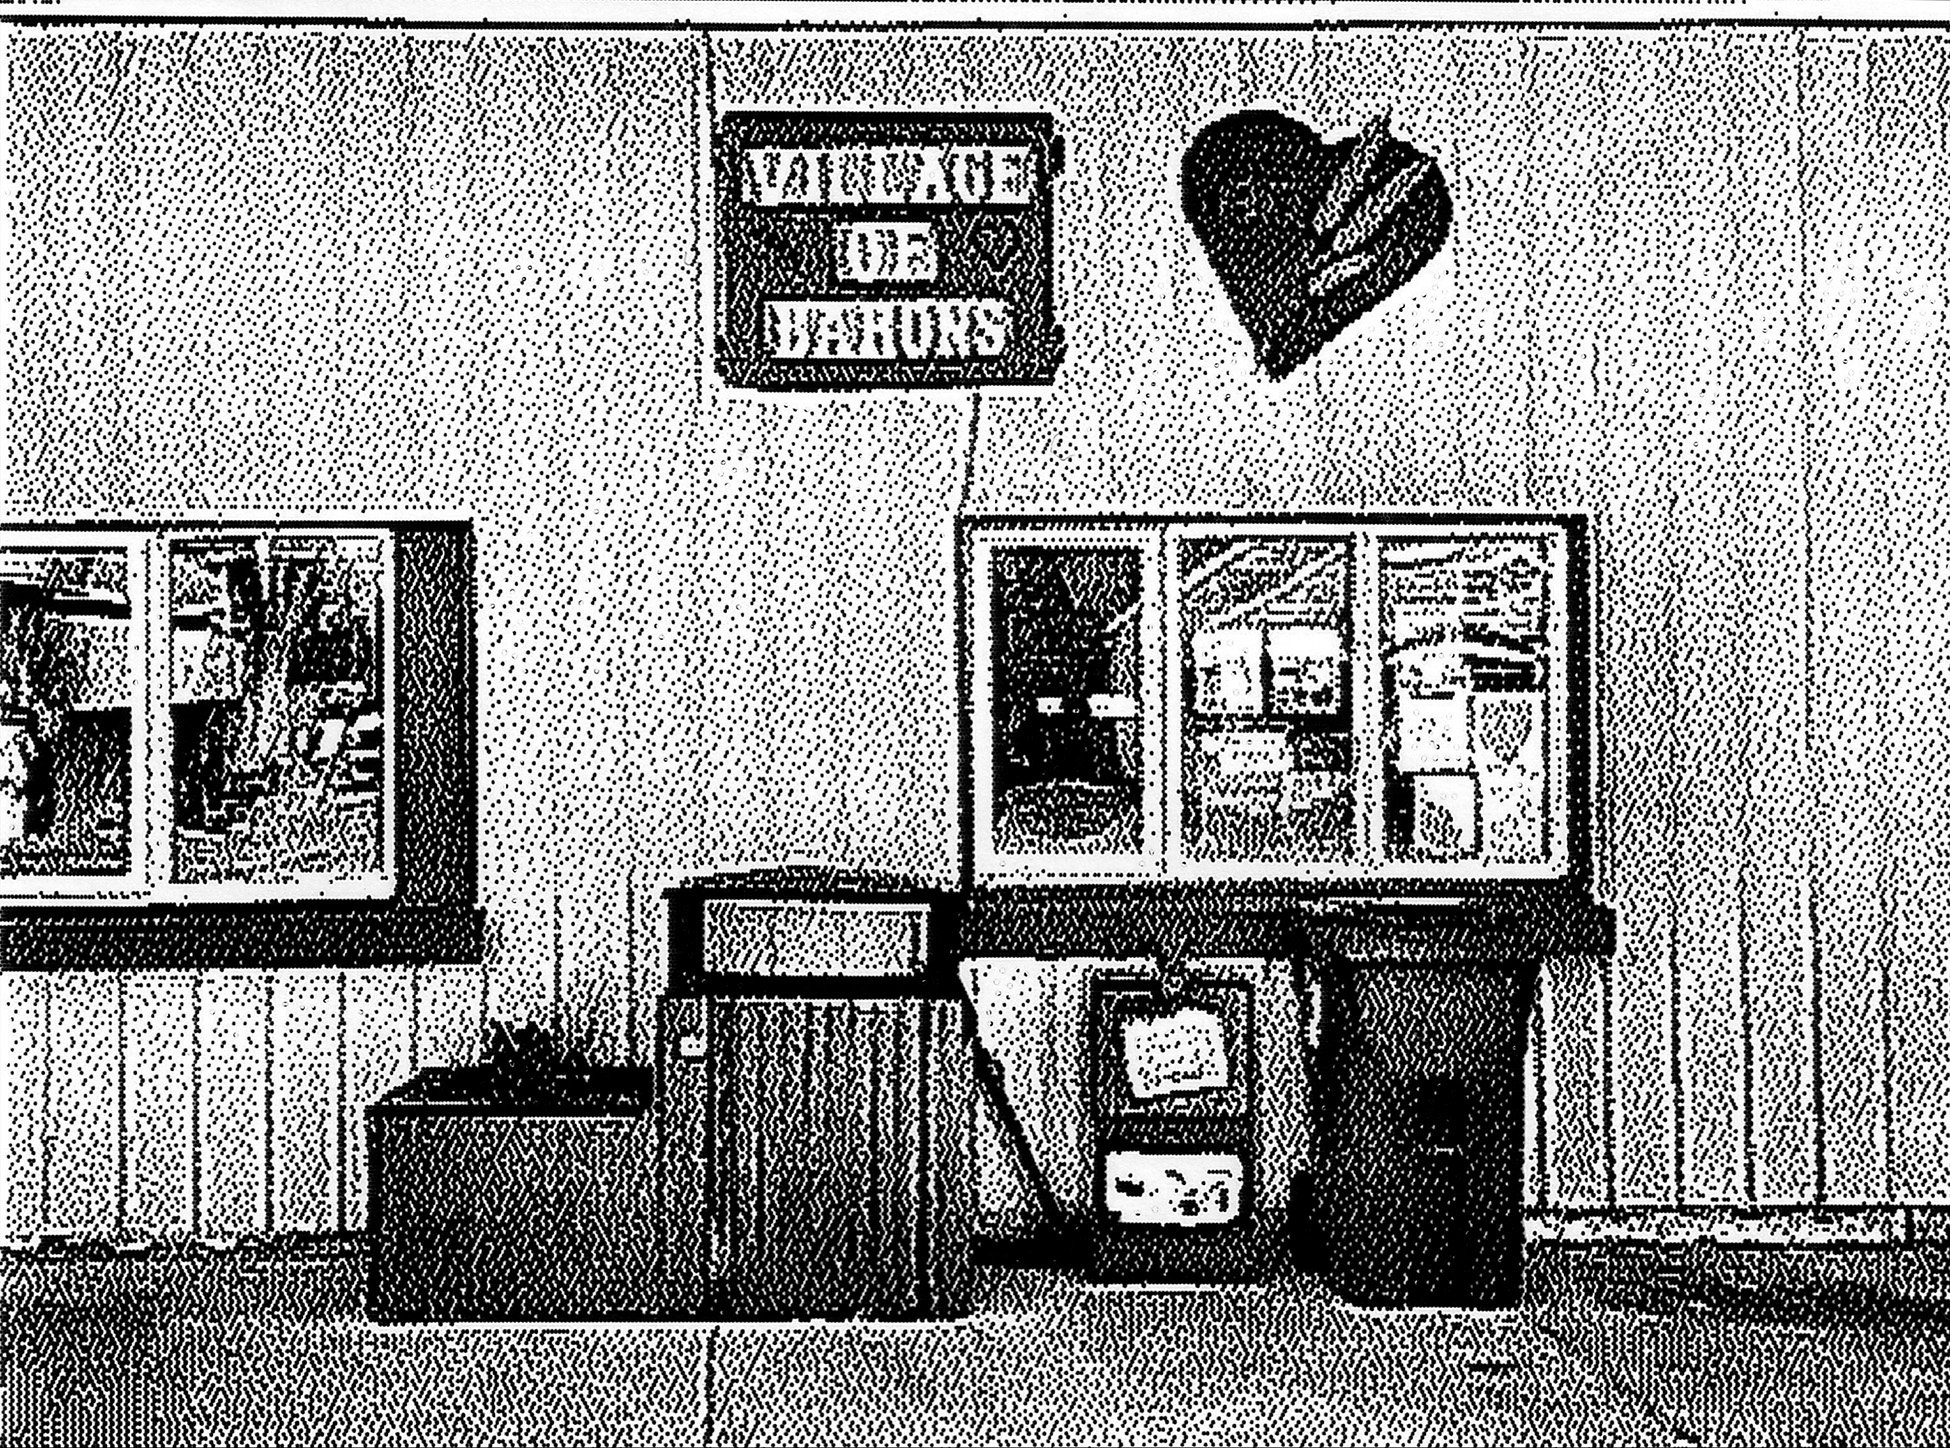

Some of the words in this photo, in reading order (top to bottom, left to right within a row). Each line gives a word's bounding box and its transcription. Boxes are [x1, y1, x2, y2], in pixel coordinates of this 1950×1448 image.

[748, 148, 1032, 204] VILLAGE
[846, 222, 935, 281] OF
[773, 299, 1013, 357] BARONS
